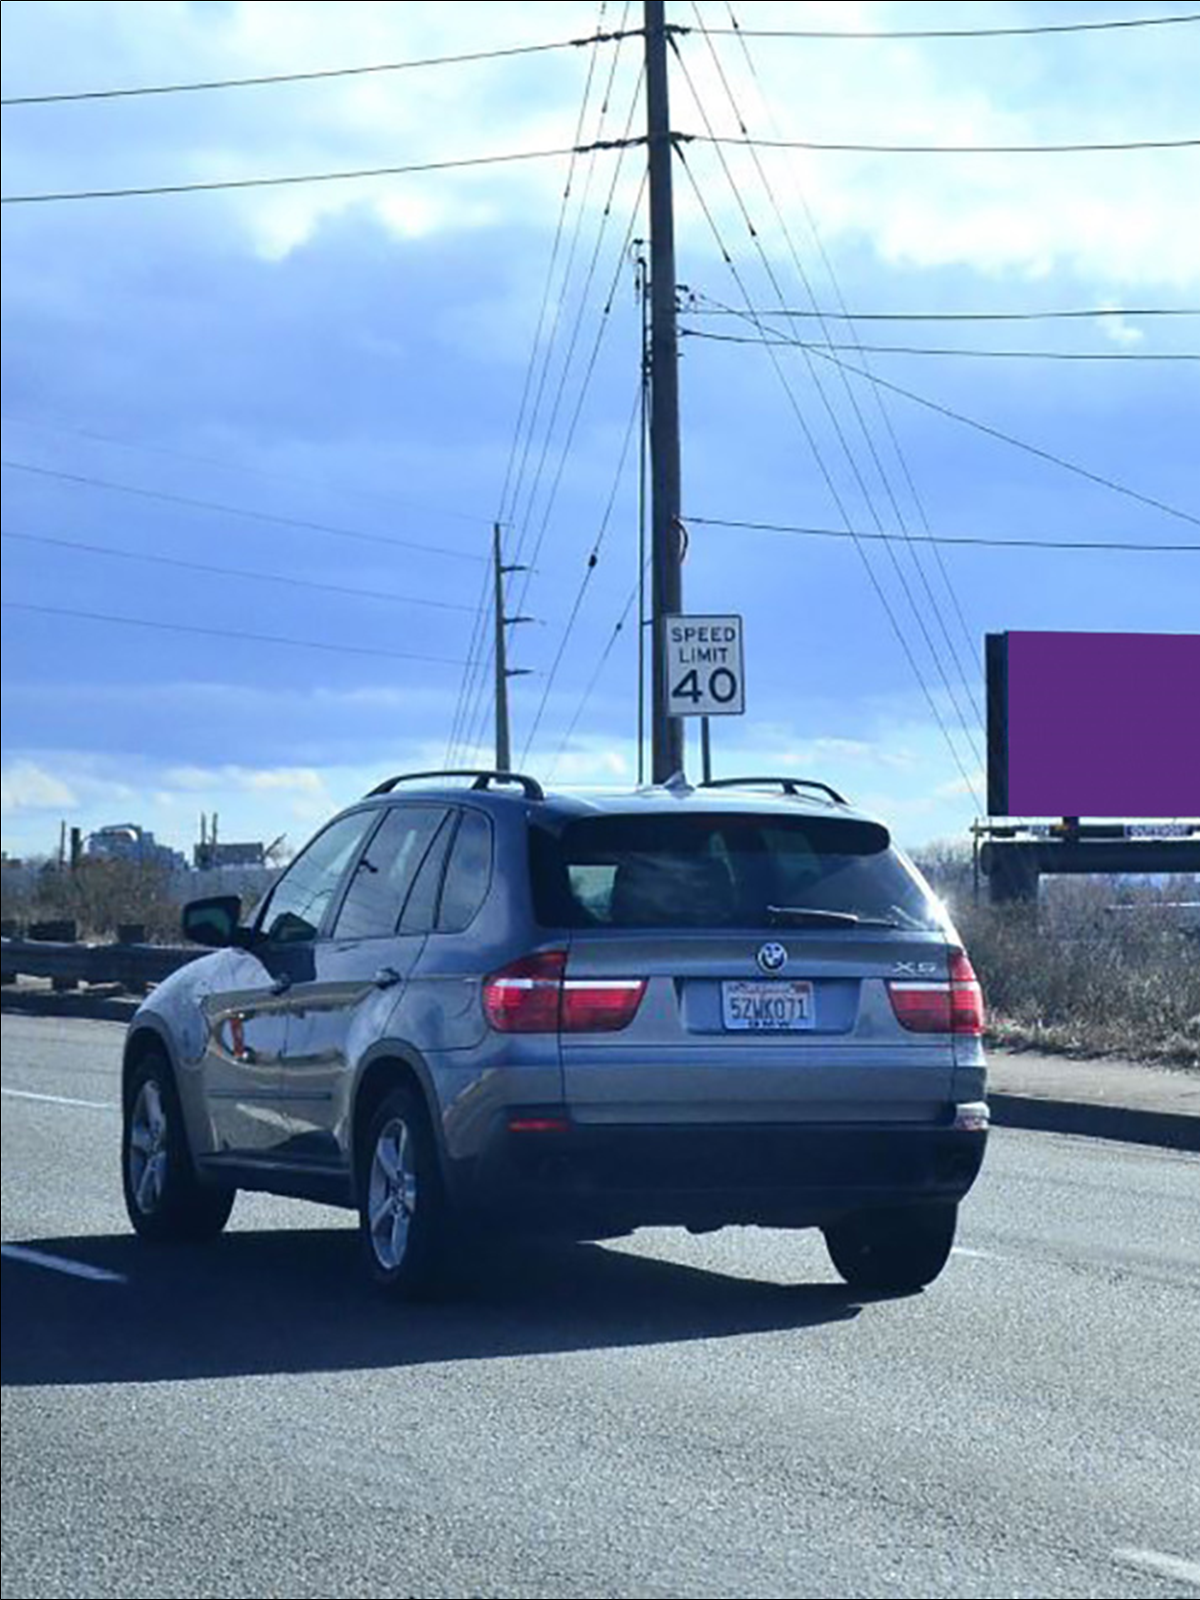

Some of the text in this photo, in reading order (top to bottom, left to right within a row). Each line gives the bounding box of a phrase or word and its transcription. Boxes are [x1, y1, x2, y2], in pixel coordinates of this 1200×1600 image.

[671, 627, 736, 642] SPEED
[679, 647, 728, 663] LIMIT
[671, 667, 737, 704] 40
[892, 961, 937, 977] X5
[730, 998, 809, 1020] 5ZWK071
